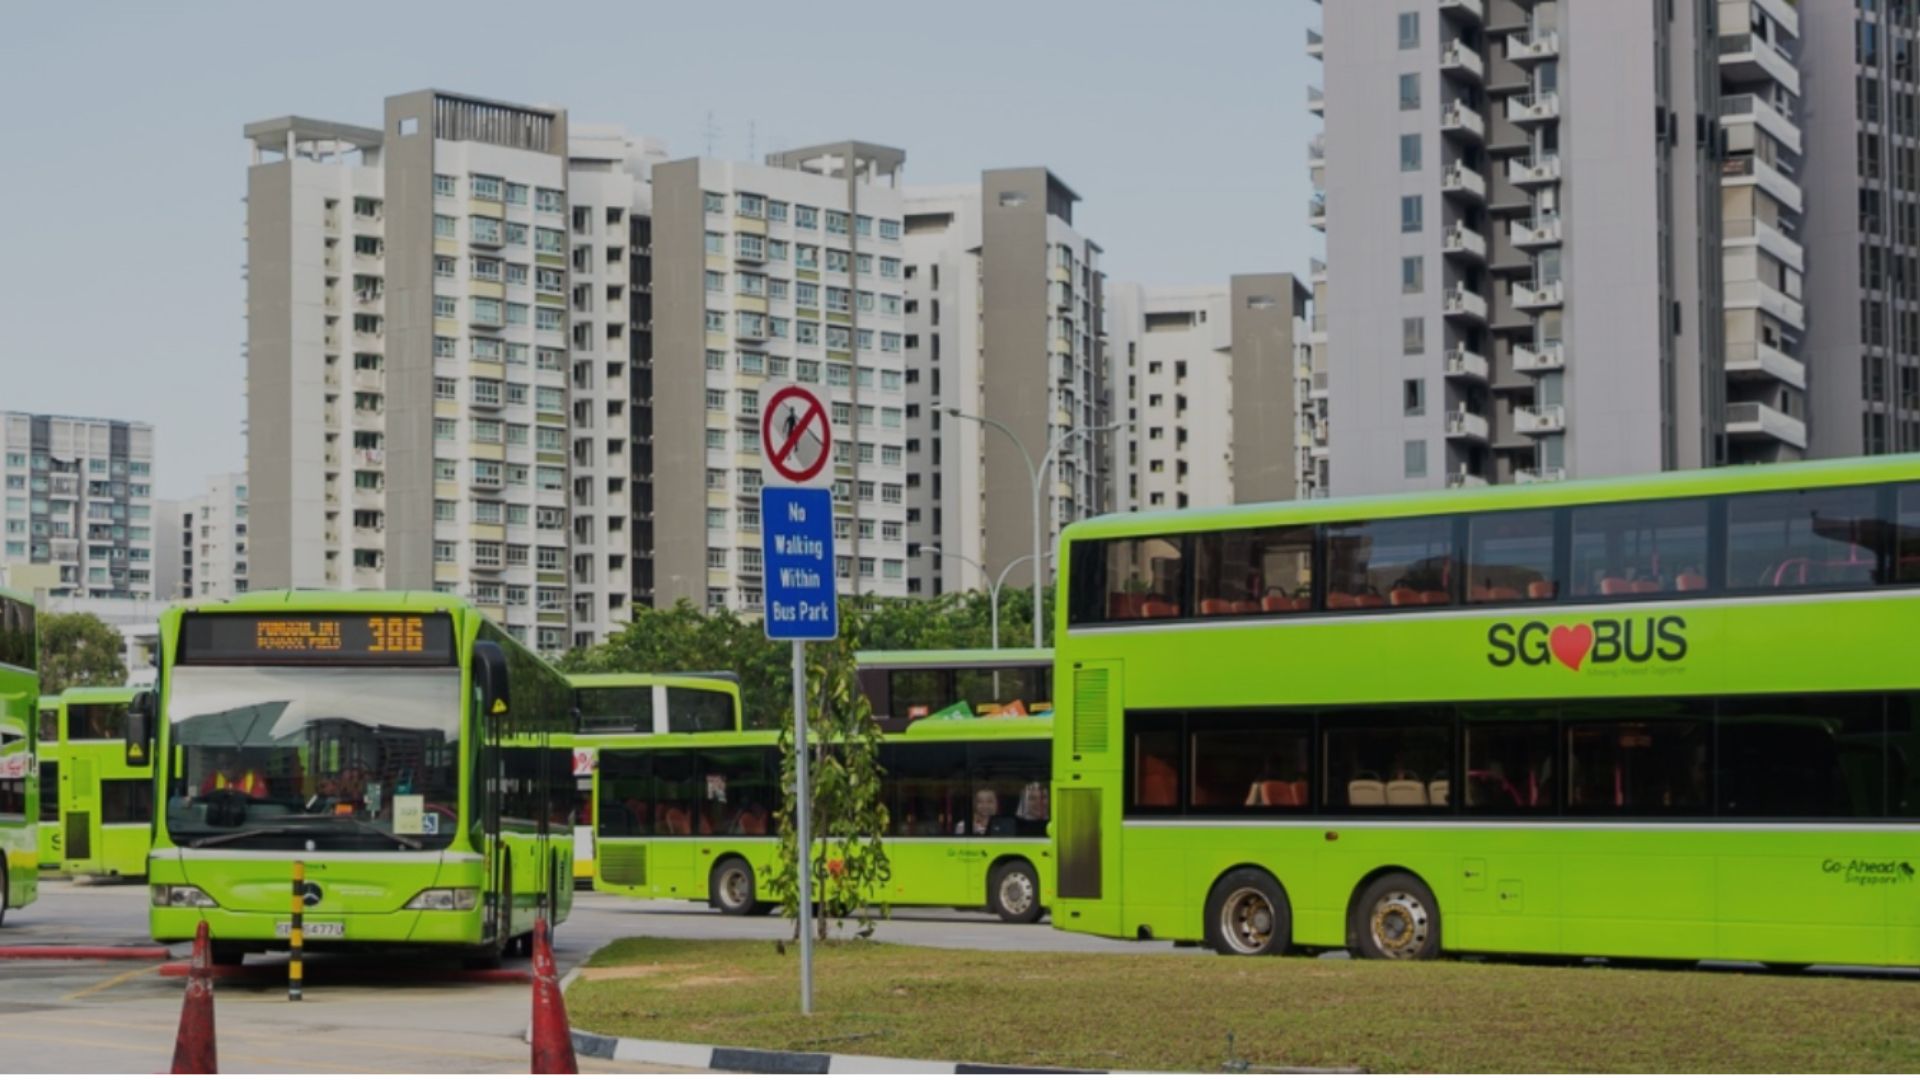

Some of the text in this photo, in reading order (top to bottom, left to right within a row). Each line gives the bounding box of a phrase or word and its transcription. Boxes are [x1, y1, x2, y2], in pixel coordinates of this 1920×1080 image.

[788, 501, 806, 522] No
[774, 535, 824, 560] Walking
[780, 567, 821, 588] Within
[773, 600, 829, 621] Bus Park
[368, 618, 423, 651] 386
[1822, 859, 1896, 873] Go-Ahead
